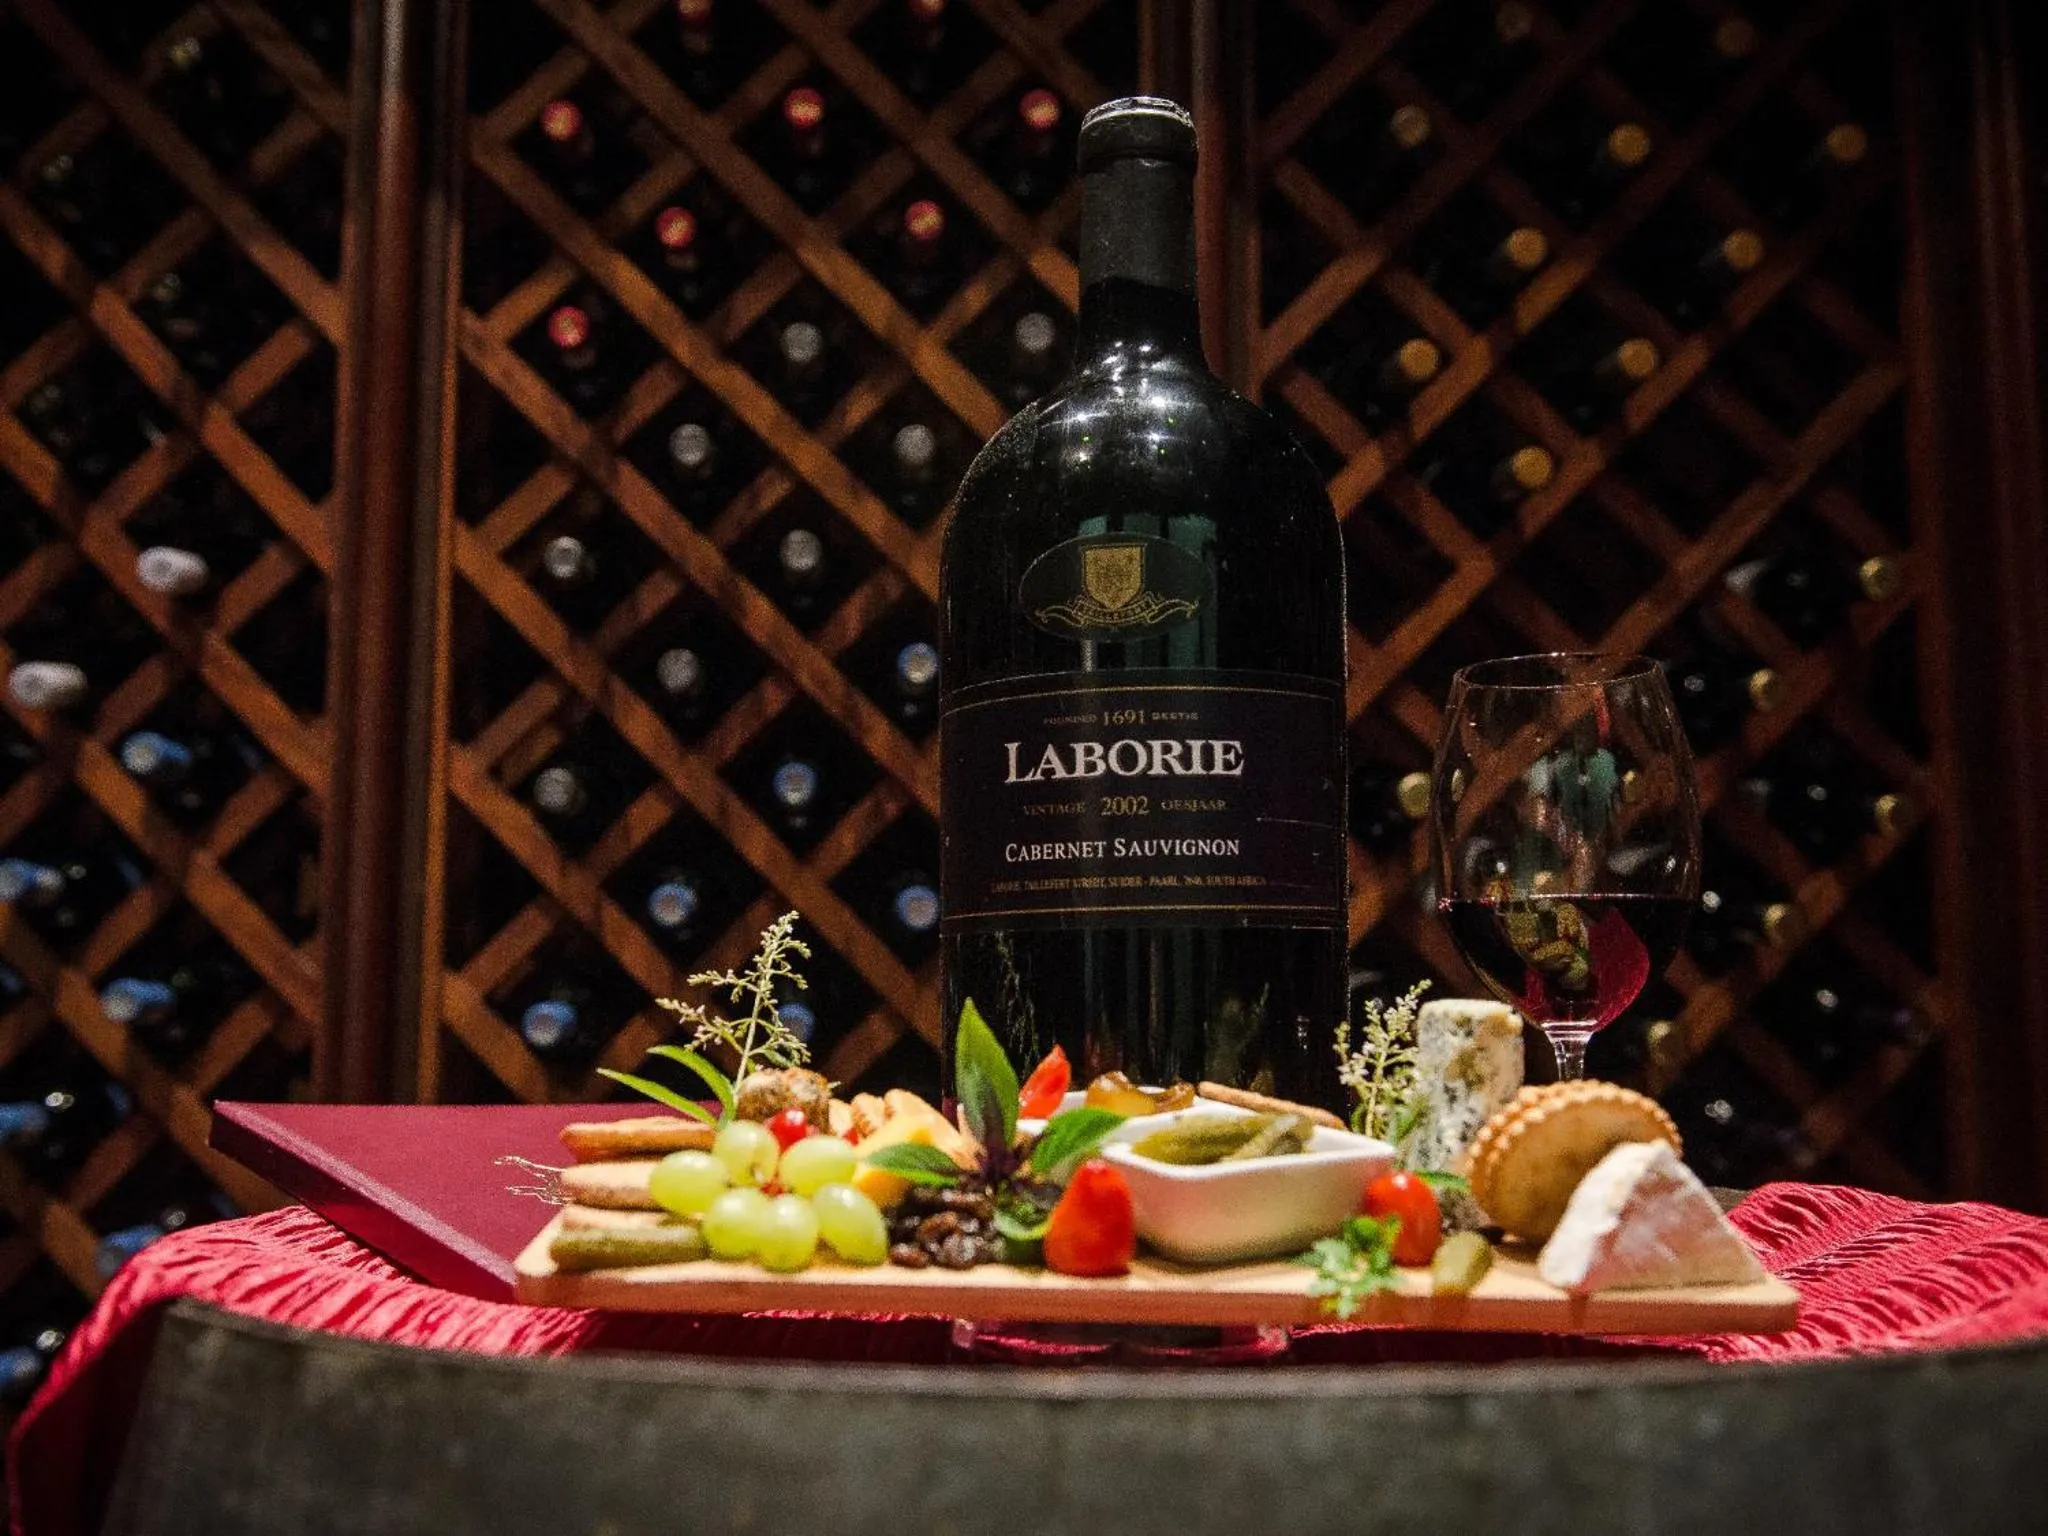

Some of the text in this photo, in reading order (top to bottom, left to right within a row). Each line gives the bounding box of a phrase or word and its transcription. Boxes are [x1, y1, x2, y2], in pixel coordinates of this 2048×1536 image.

[1103, 709, 1146, 726] 1691
[1004, 739, 1244, 784] LABORIE
[1023, 801, 1086, 816] VINTAGE
[1101, 796, 1149, 816] 2002
[1005, 837, 1241, 863] CABERNET SAUVIGNON
